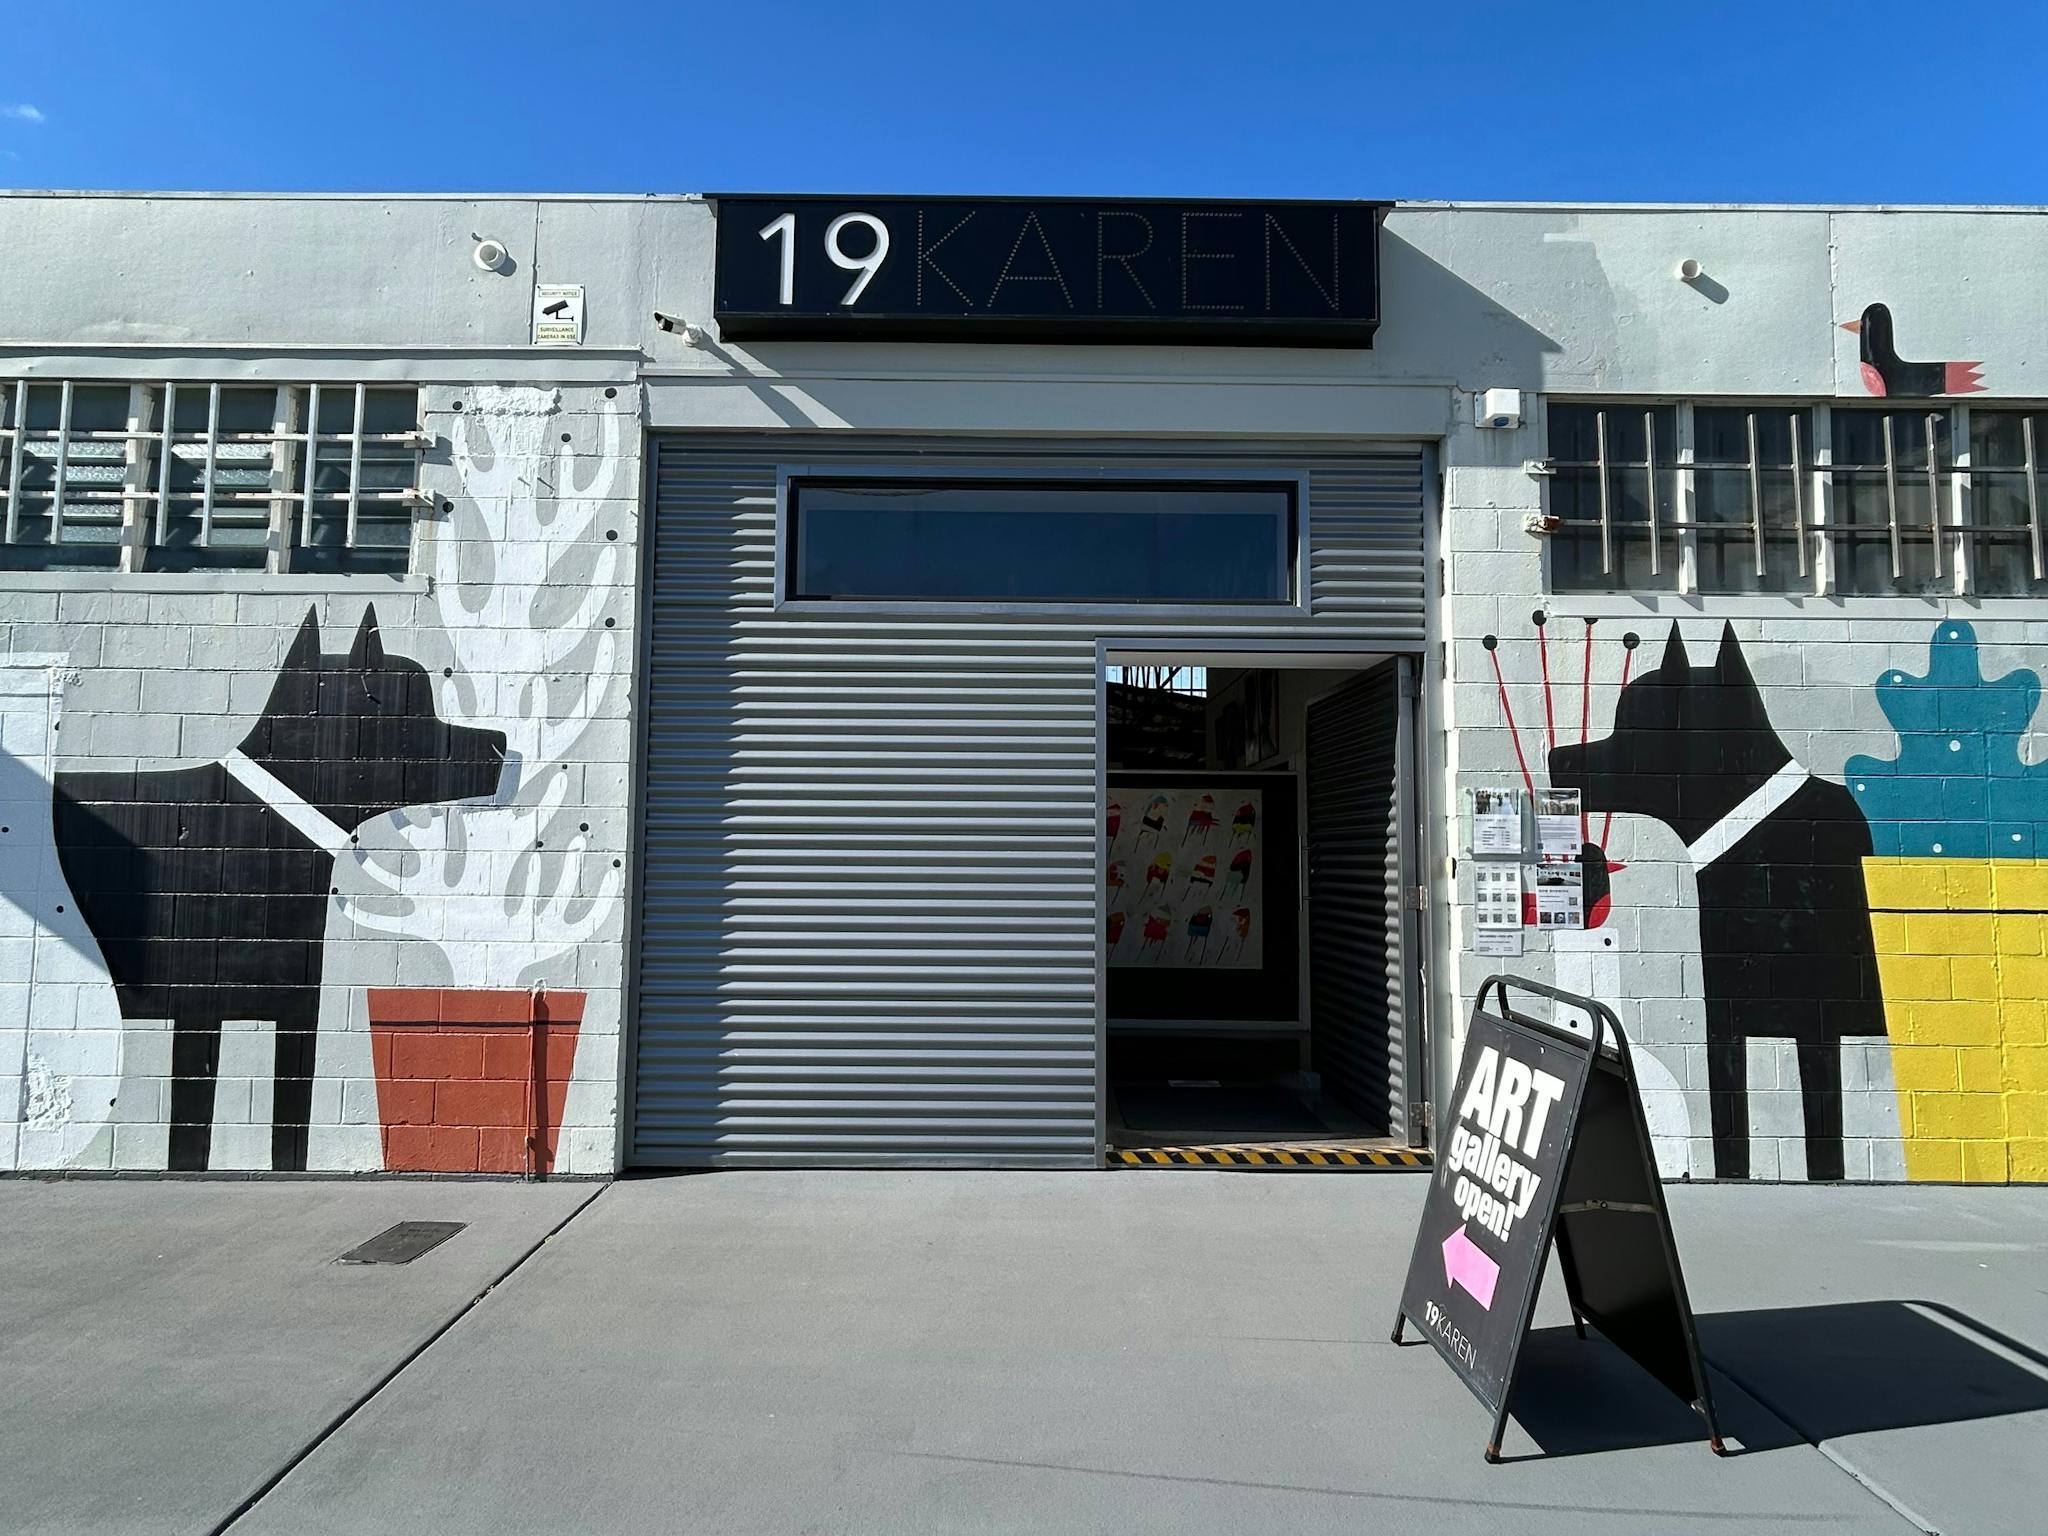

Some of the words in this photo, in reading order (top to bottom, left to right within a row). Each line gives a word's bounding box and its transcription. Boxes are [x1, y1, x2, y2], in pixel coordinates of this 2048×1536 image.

[1459, 1045, 1565, 1160] ART
[1448, 1125, 1541, 1219] gallery
[1454, 1175, 1516, 1243] open!
